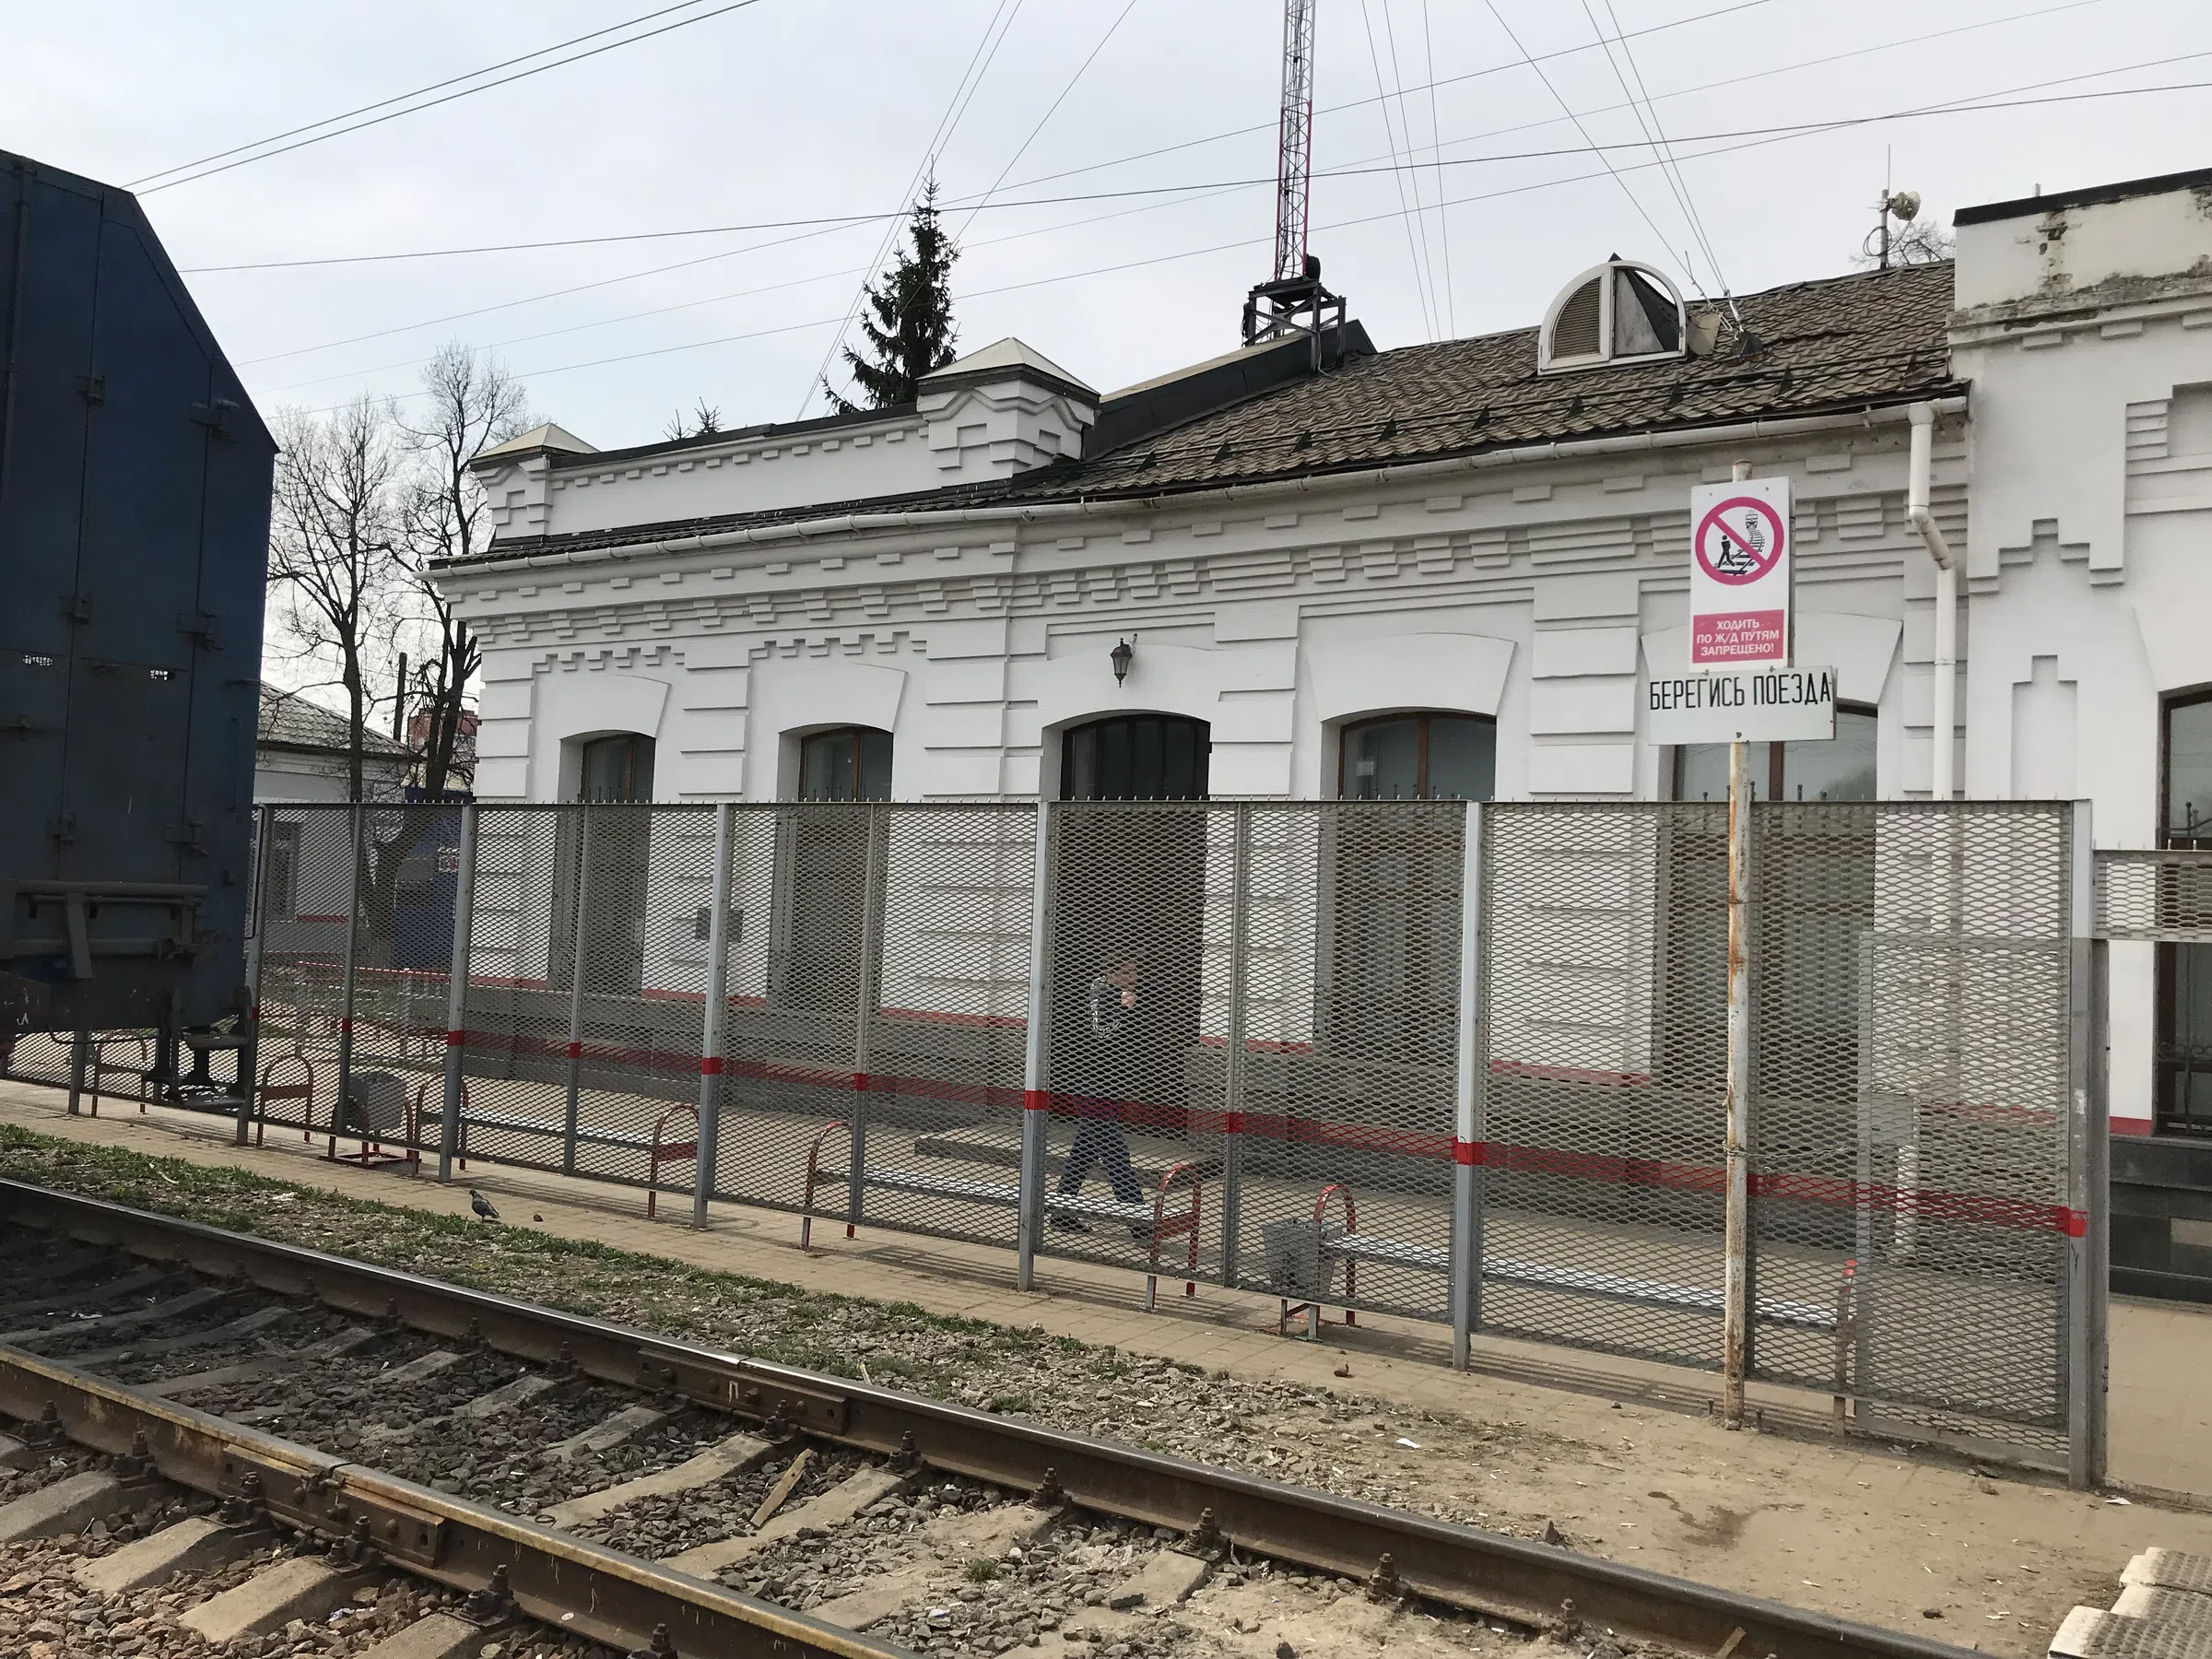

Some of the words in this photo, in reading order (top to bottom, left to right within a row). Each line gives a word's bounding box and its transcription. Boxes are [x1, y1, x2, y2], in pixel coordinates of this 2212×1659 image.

[1716, 618, 1760, 630] ХОДИТЬ
[1697, 634, 1712, 644] ПО
[1714, 632, 1739, 644] Ж/Д
[1741, 629, 1780, 641] ПУТЯМ
[1700, 642, 1774, 656] ЗАПРЕЩЕНО!
[1650, 677, 1745, 711] БЕРЕГИСЬ
[1753, 672, 1831, 706] ПОЕЗДА
